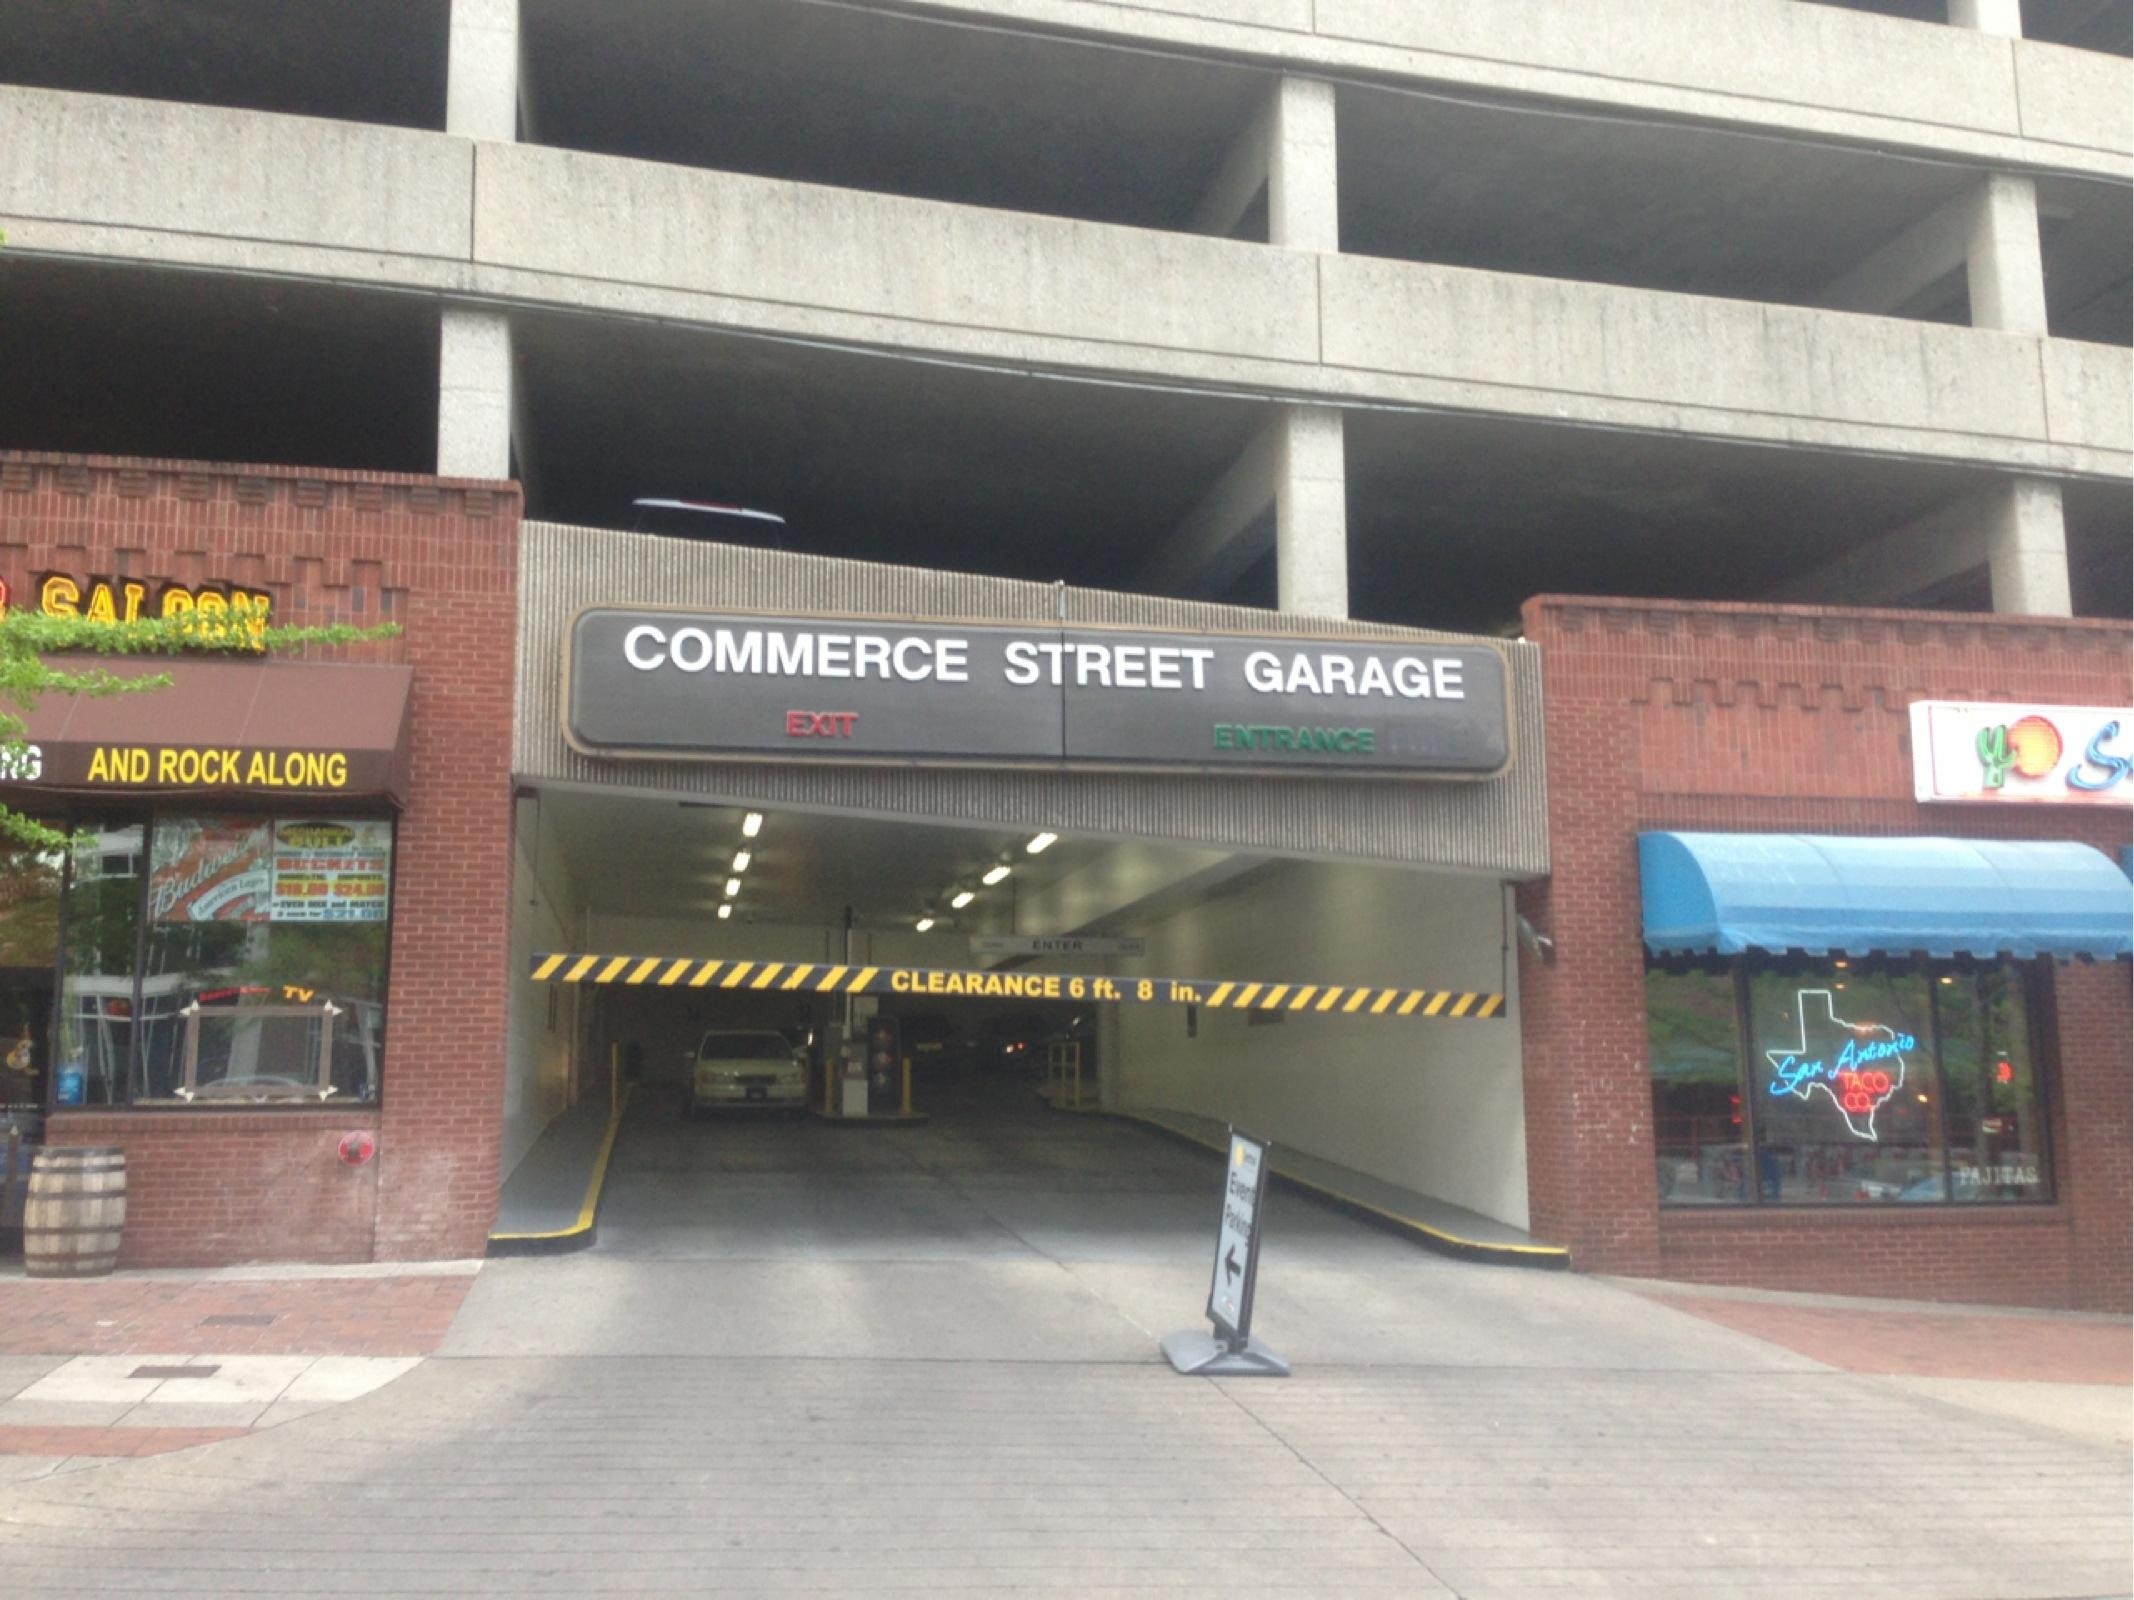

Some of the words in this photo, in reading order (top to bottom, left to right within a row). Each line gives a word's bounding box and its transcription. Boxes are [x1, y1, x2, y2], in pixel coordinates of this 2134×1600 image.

[624, 624, 969, 683] COMMERCE
[1003, 641, 1214, 691] STREET
[1244, 651, 1465, 700] GARAGE
[786, 710, 859, 738] EXIT
[1213, 723, 1376, 755] ENTRANCE
[87, 747, 149, 782] AND
[159, 749, 241, 785] ROCK
[247, 751, 348, 787] ALONG
[1032, 938, 1084, 950] ENTER
[282, 984, 315, 1003] TV
[891, 970, 1061, 998] CLEARANCE
[1069, 976, 1086, 999] 6
[1093, 978, 1122, 999] ft.
[1137, 979, 1154, 1001] 8
[1170, 981, 1202, 1003] in.
[1769, 1055, 1824, 1096] San
[1827, 1032, 1915, 1079] Antonio
[1843, 1071, 1890, 1093] TACO
